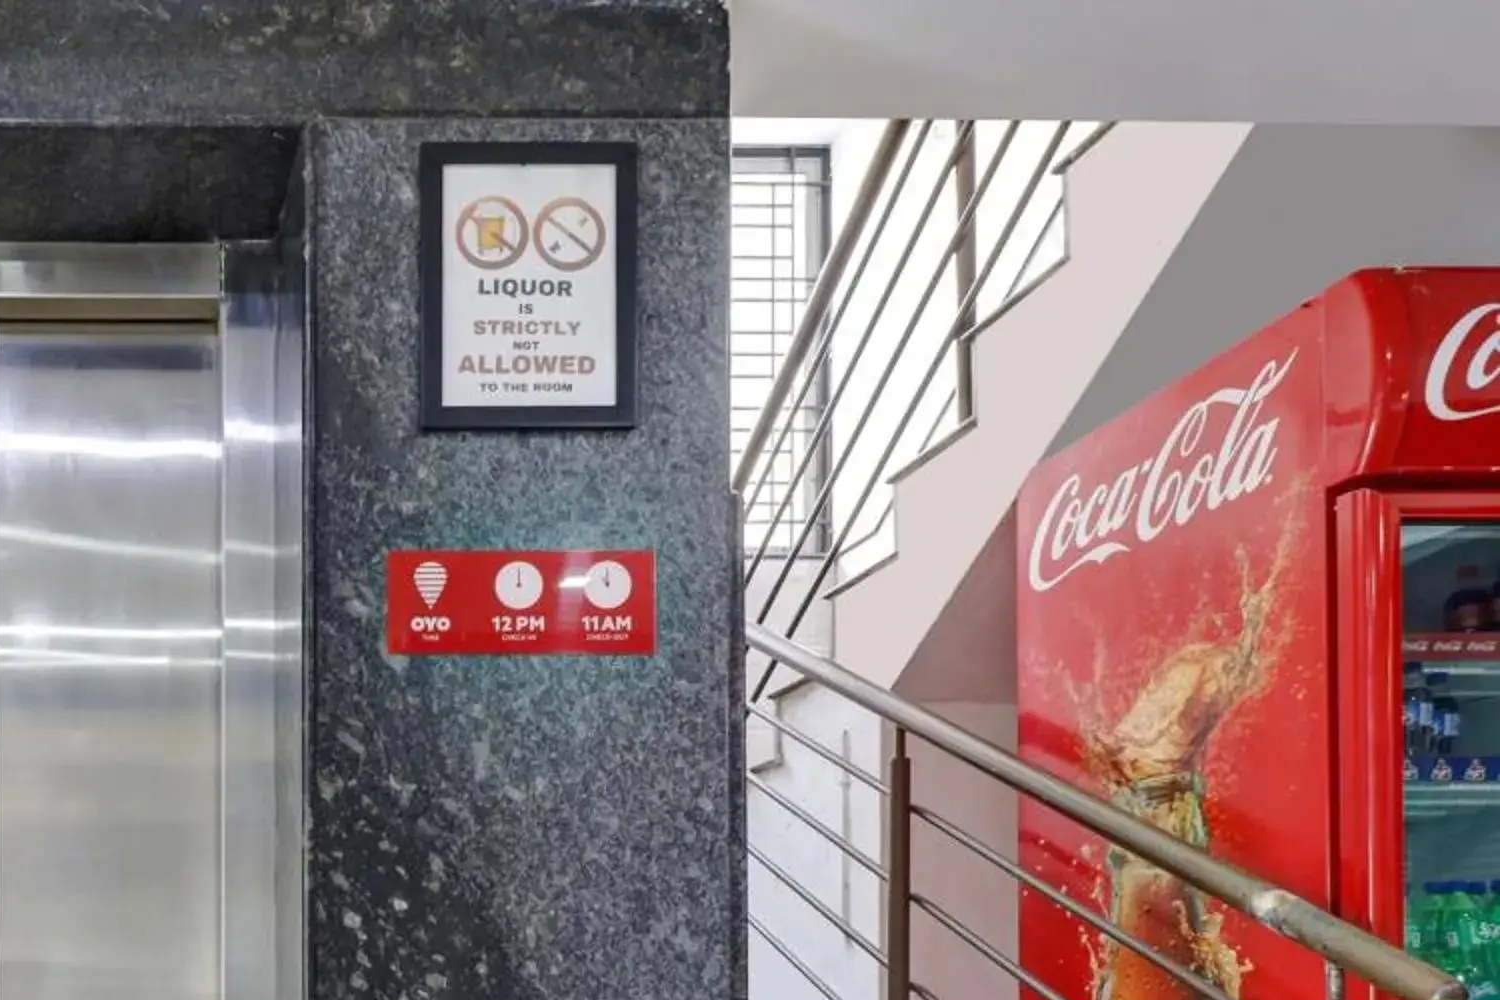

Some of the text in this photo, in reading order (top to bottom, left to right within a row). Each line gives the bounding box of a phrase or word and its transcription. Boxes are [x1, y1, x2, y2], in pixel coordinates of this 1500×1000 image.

[478, 279, 573, 297] LIQUOR
[519, 304, 533, 314] IS
[473, 321, 581, 336] STRICTLY
[513, 341, 540, 350] NOT
[458, 355, 596, 375] ALLOWED
[480, 382, 573, 392] TO THE ROOM
[411, 616, 450, 631] OYO
[491, 616, 545, 632] 12 PM
